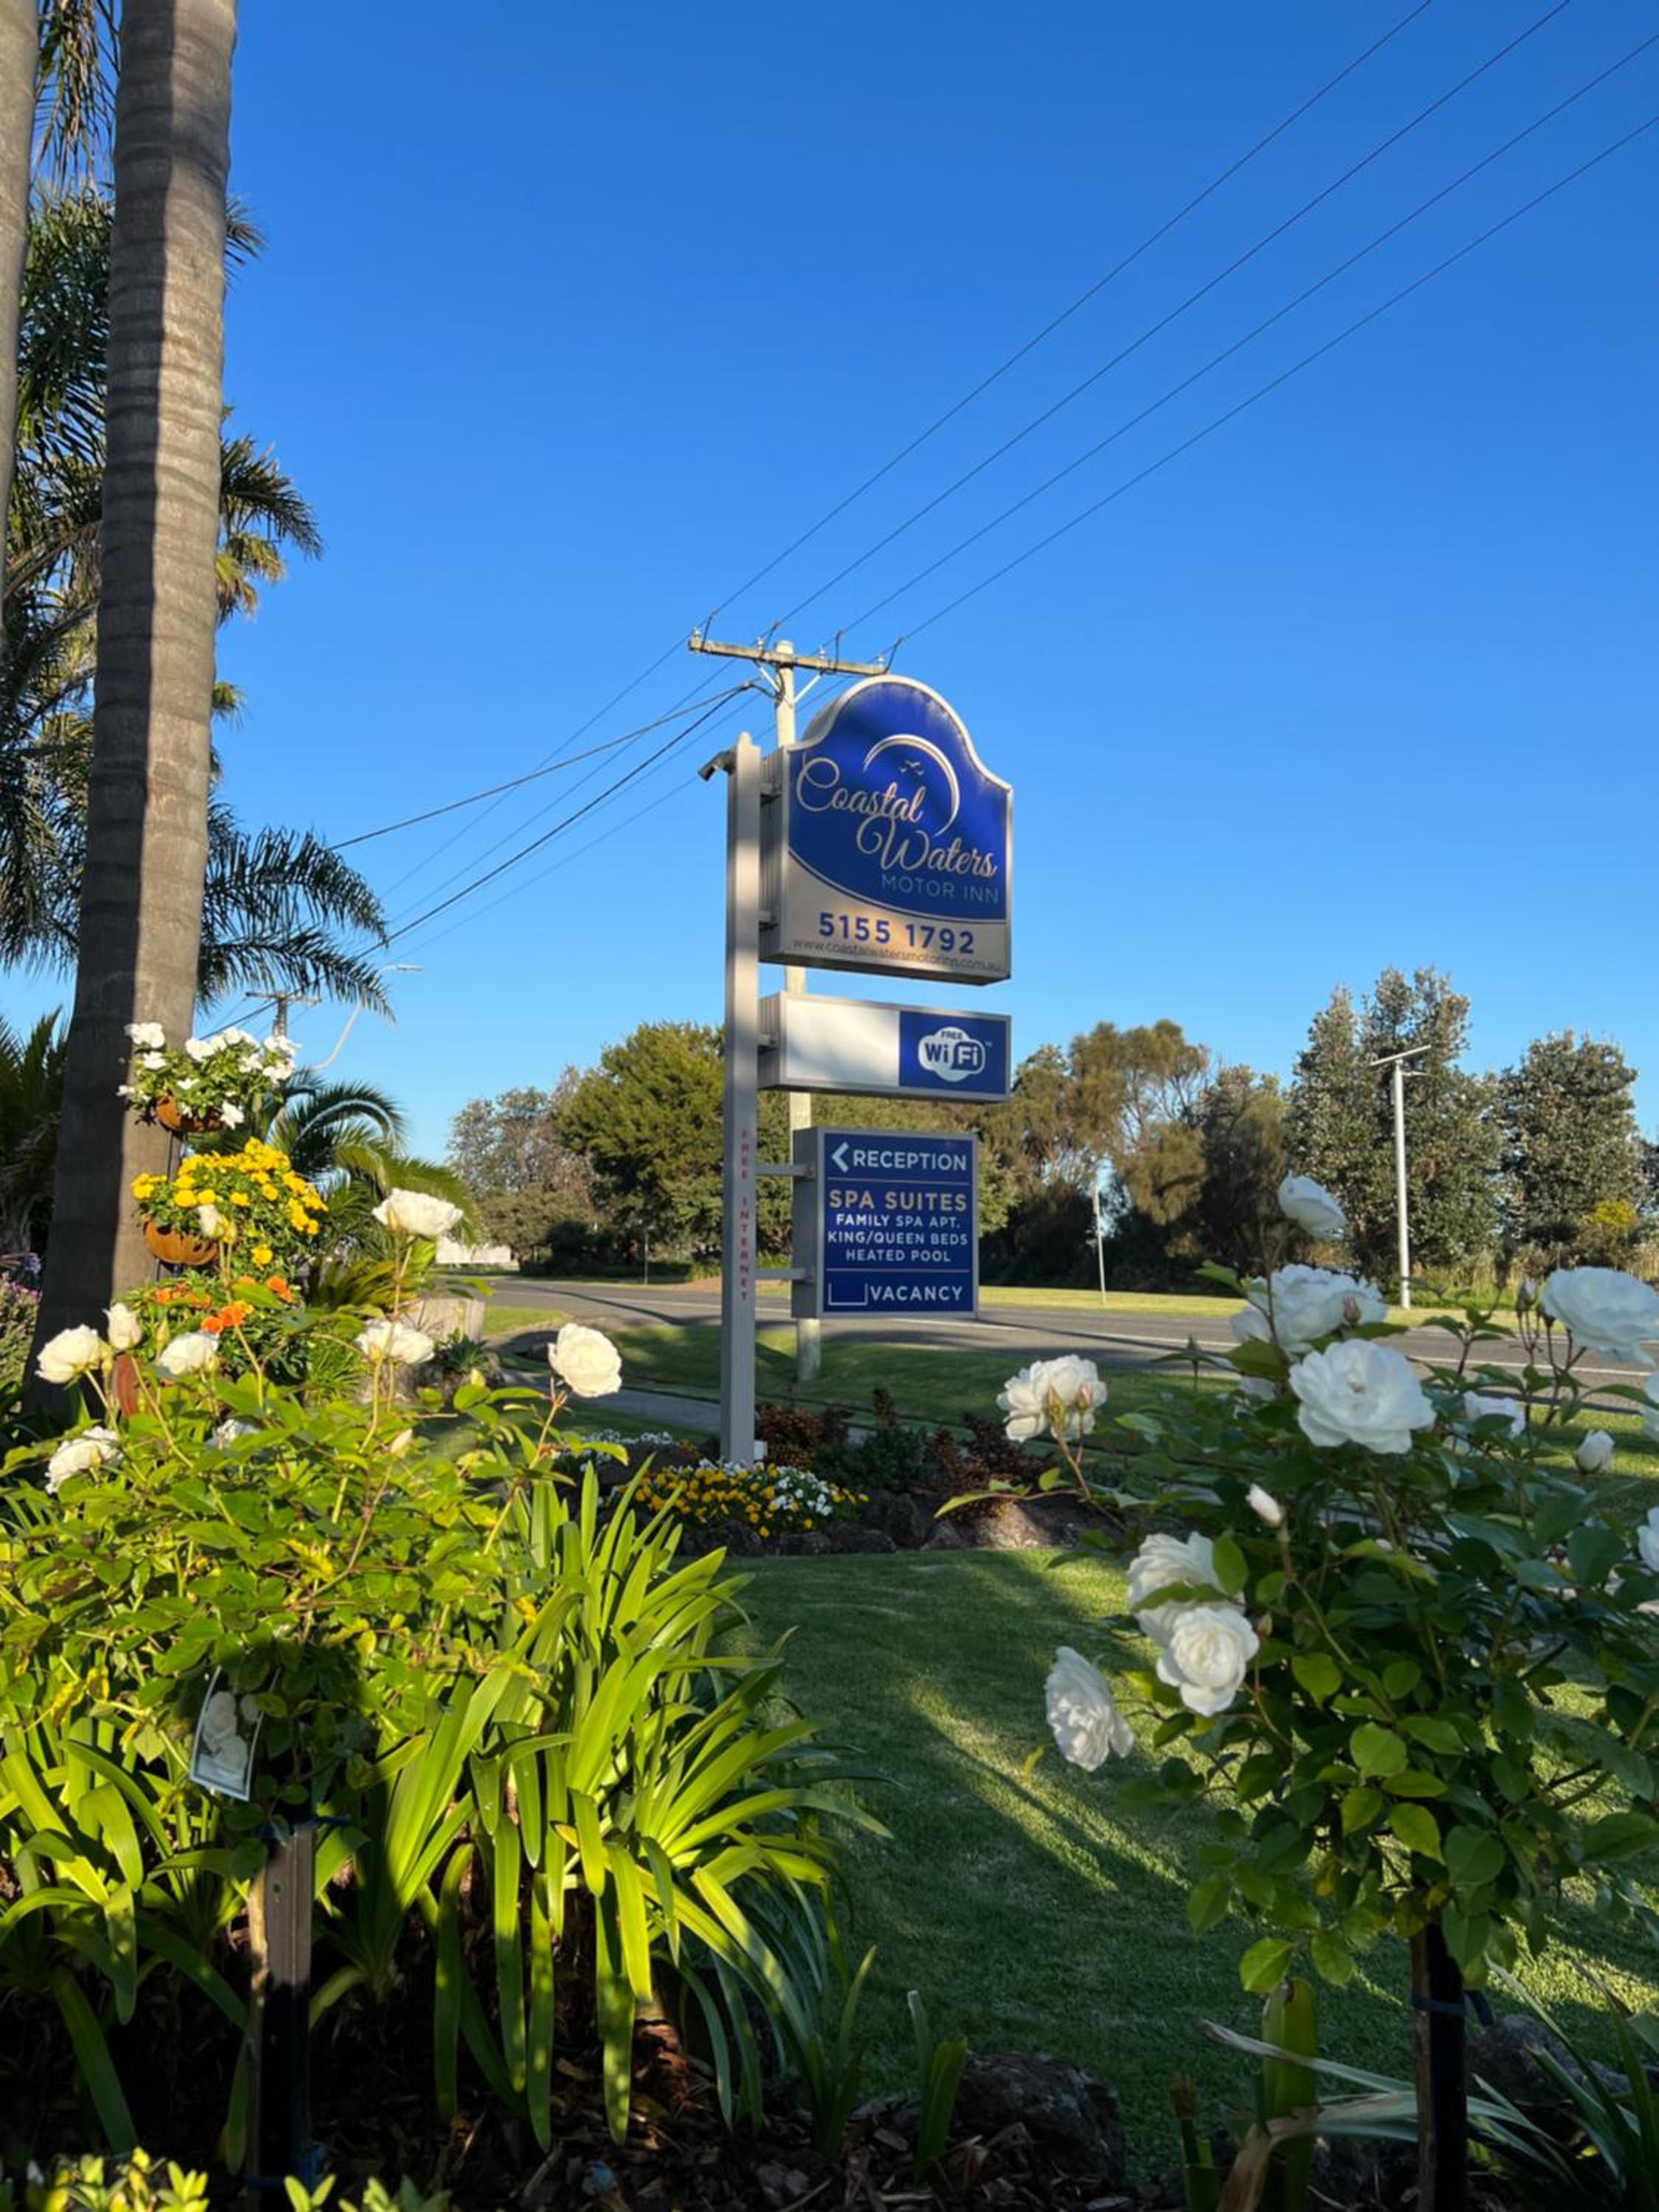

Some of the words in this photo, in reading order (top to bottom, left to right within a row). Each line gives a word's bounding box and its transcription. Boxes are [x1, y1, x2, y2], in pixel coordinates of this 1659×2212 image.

[797, 752, 926, 823] Coastal
[857, 814, 997, 877] Waters
[882, 874, 955, 897] MOTOR
[964, 886, 999, 904] INN
[819, 912, 891, 944] 5155
[906, 924, 974, 954] 1792
[741, 1130, 749, 1179] FREE
[853, 1150, 967, 1171] RECEPTION
[829, 1189, 874, 1209] SPA
[885, 1191, 967, 1211] SUITES
[835, 1214, 890, 1226] FAMILY
[896, 1216, 923, 1228] SPA
[929, 1217, 961, 1228] APT.
[740, 1197, 750, 1301] INTERNET
[827, 1231, 925, 1245] KING/QUEEN
[931, 1233, 968, 1245] BEDS
[846, 1249, 905, 1262] HEATED
[911, 1251, 951, 1262] POOL
[869, 1285, 963, 1301] VACANCY
